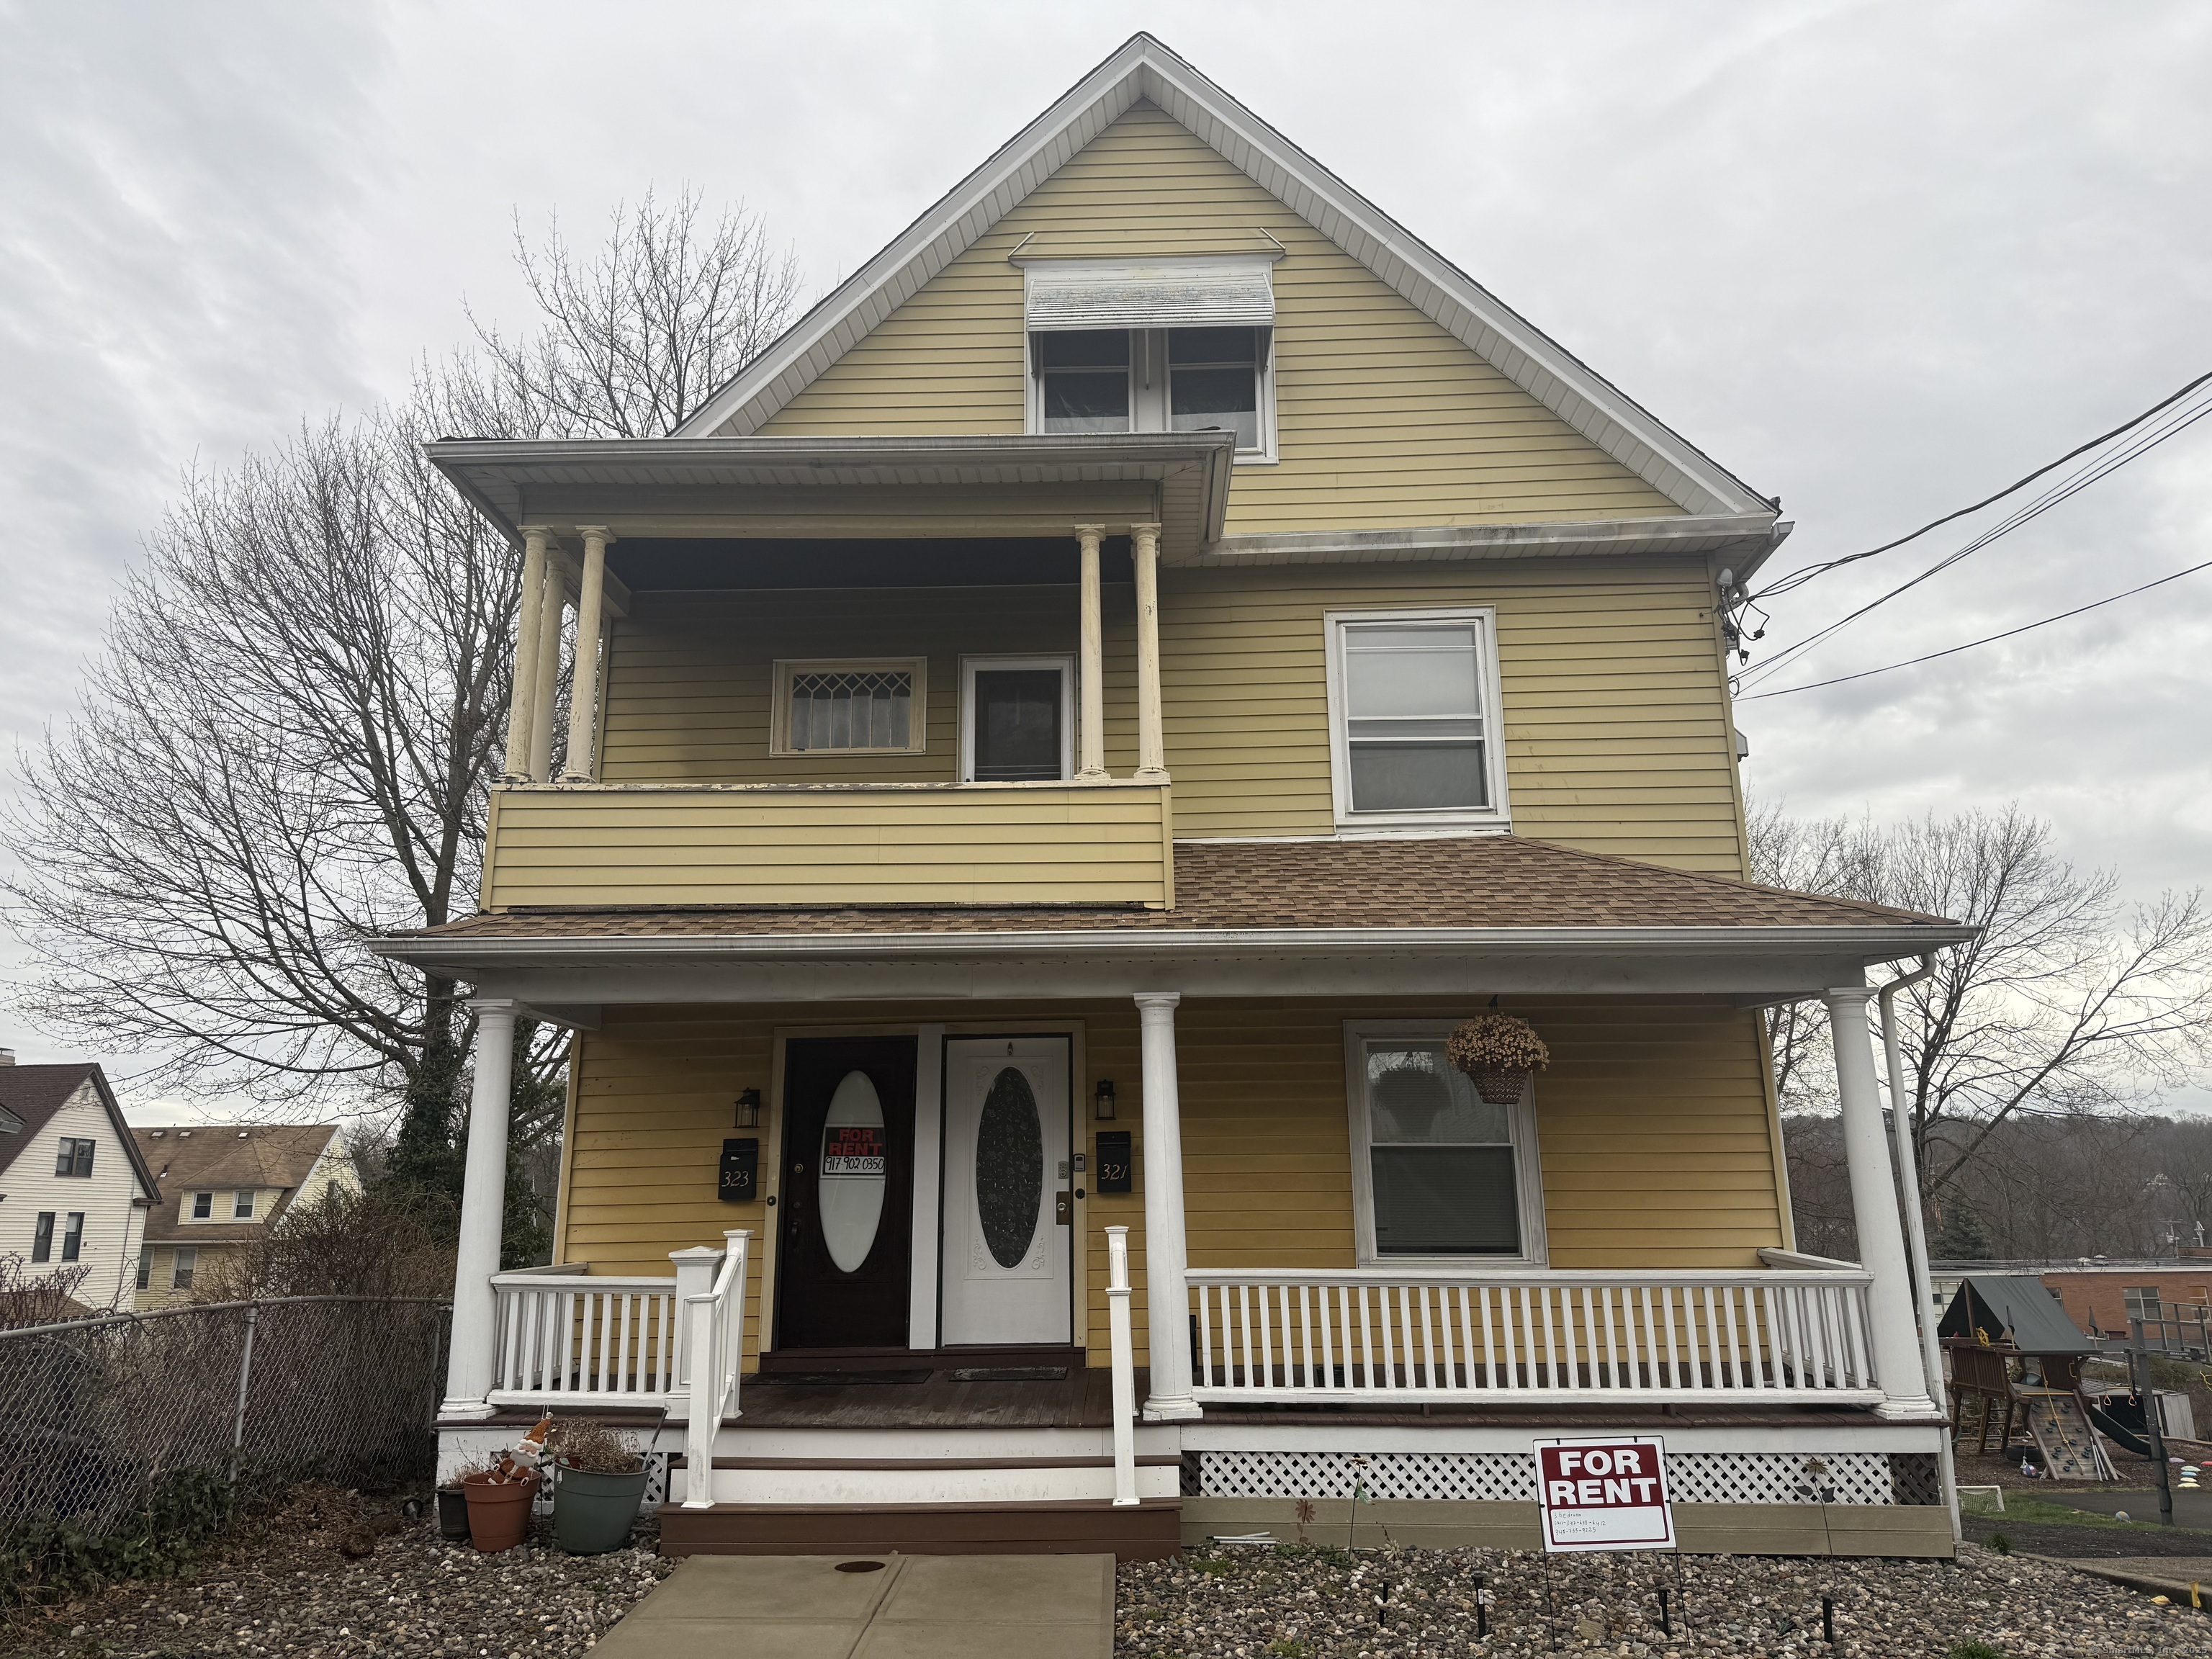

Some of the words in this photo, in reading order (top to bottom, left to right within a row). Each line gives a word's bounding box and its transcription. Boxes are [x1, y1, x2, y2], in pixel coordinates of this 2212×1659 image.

[839, 1129, 873, 1142] FOR
[829, 1142, 883, 1156] RENT
[721, 1171, 749, 1187] 323
[1101, 1164, 1128, 1180] 321
[1559, 1449, 1642, 1476] FOR
[1549, 1478, 1657, 1506] RENT
